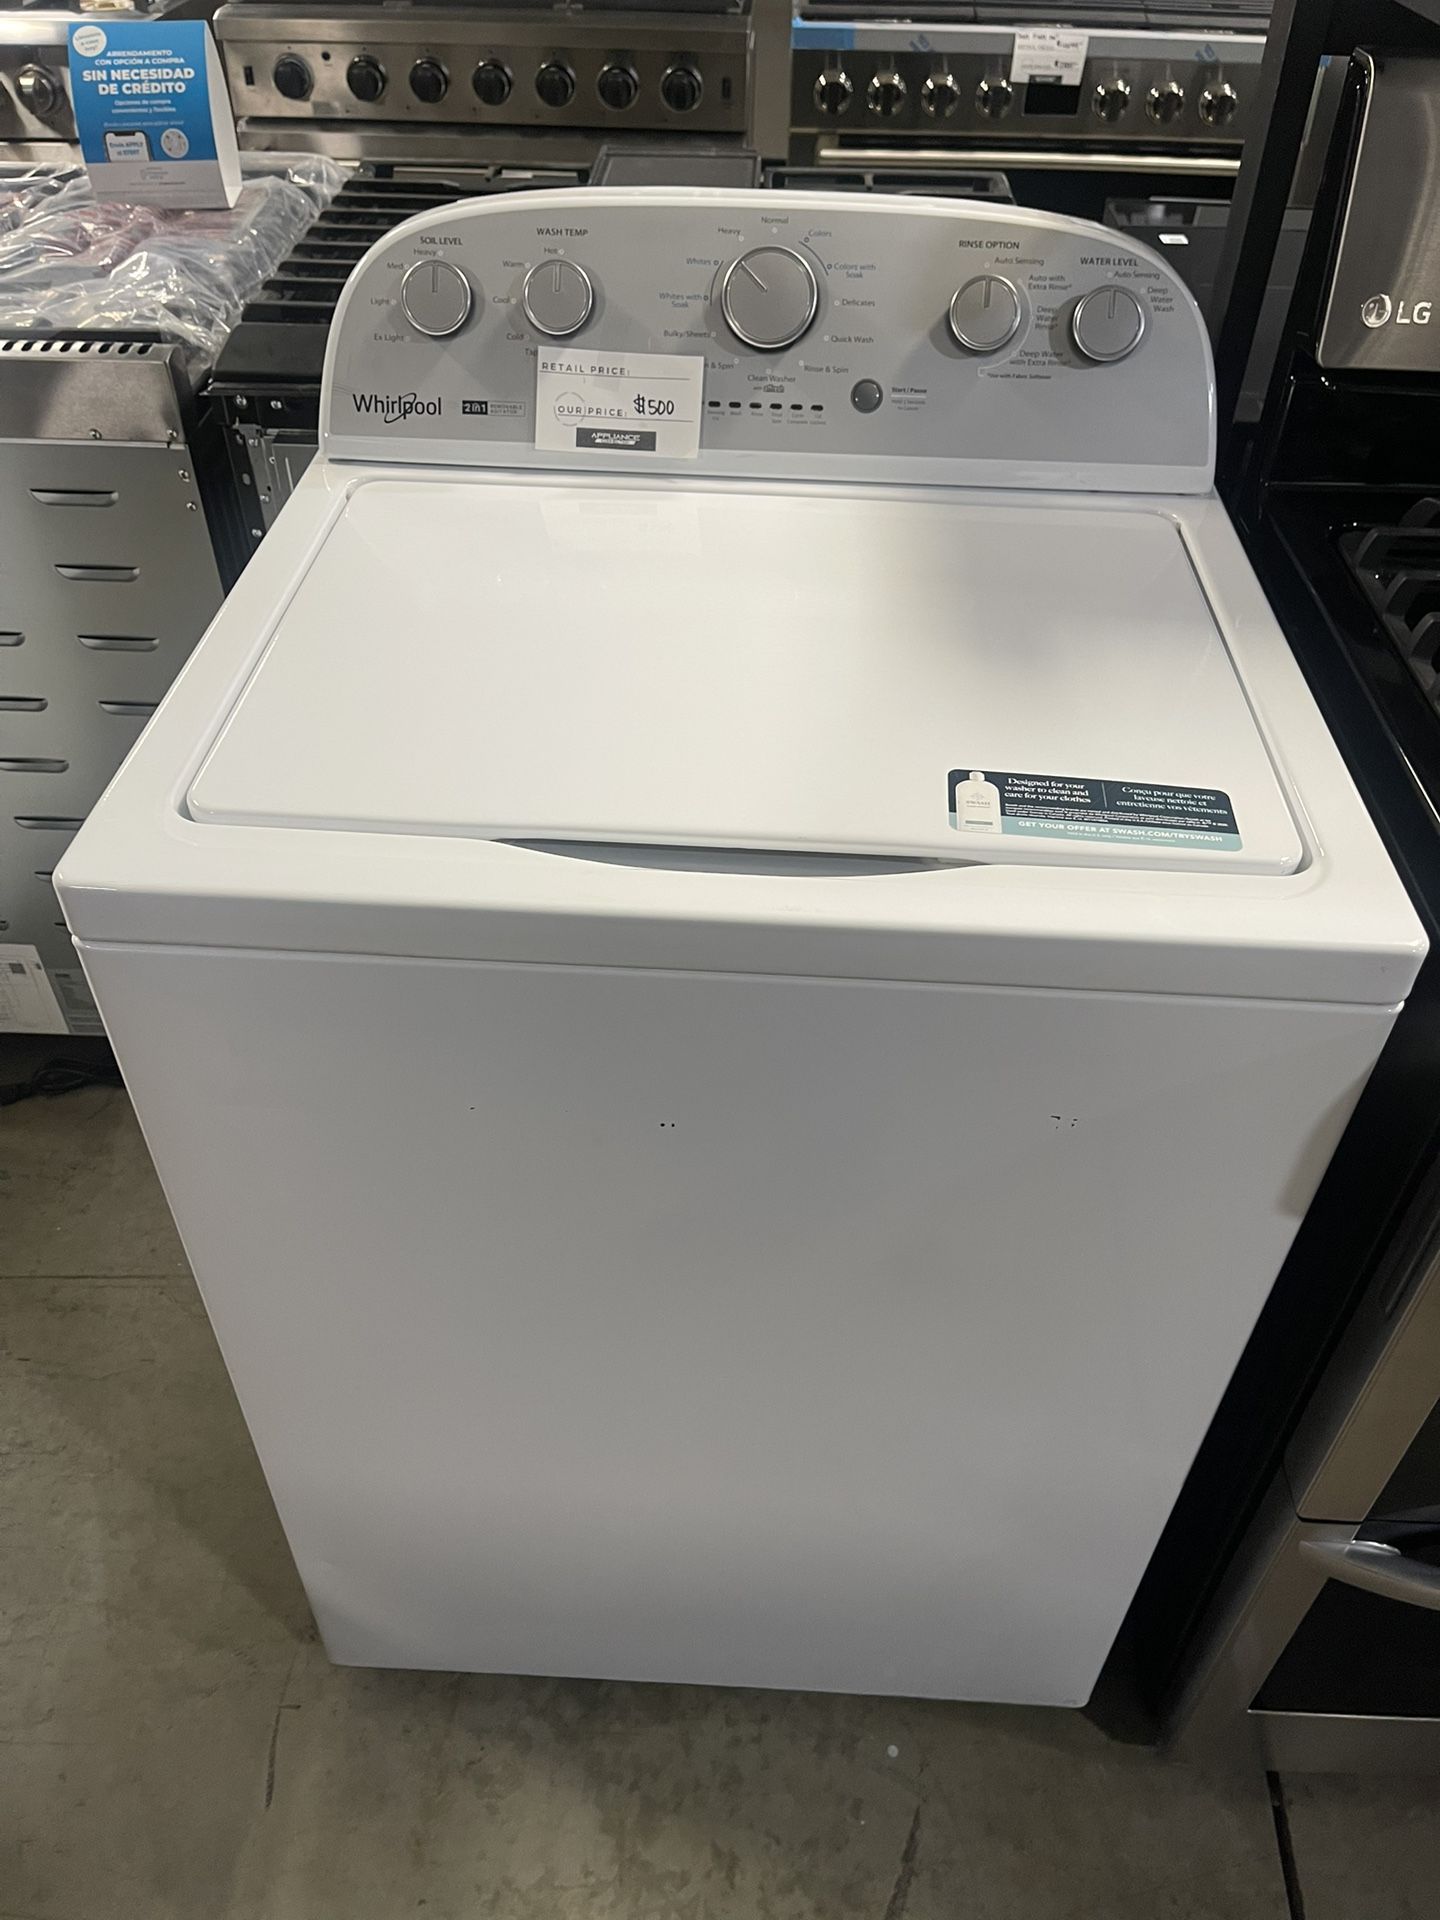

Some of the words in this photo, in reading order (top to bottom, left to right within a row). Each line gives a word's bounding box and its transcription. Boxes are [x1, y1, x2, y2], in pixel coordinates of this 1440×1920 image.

[94, 58, 112, 66] CON
[113, 57, 143, 65] OPCIÓN
[151, 57, 185, 65] COMPRA
[82, 69, 107, 81] SIN
[110, 67, 195, 81] NECESIDAD
[98, 83, 119, 95] DE
[122, 80, 186, 95] CRÉDITO
[761, 216, 789, 224] Normal
[537, 227, 562, 236] WASH
[564, 228, 588, 237] TEMP
[718, 227, 741, 235] Heavy
[808, 229, 832, 237] Colors
[420, 236, 438, 244] SOIL
[439, 237, 463, 246] LEVEL
[959, 240, 983, 249] RINSE
[985, 240, 1020, 250] OPTION
[413, 248, 436, 257] Heavy
[544, 247, 558, 255] Hot
[502, 260, 525, 268] Warm
[686, 257, 712, 265] Whites
[1015, 257, 1045, 267] Sensing
[1080, 257, 1111, 266] WATER
[1112, 258, 1138, 267] LEVEL
[387, 262, 403, 270] Med
[1113, 270, 1132, 278] Auto
[1133, 271, 1160, 280] Sensing
[1147, 287, 1168, 295] Deep
[492, 296, 511, 304] Cool
[659, 292, 684, 300] Whites
[1150, 296, 1174, 304] Water
[370, 297, 390, 306] Light
[842, 298, 875, 307] Delicates
[1153, 305, 1175, 313] Wash
[1396, 300, 1432, 324] LG
[374, 333, 383, 341] Ex
[384, 333, 404, 343] Light
[506, 332, 524, 341] Cold
[831, 335, 852, 343] Quick
[853, 335, 874, 343] Wash
[1019, 350, 1040, 358] Deep
[542, 362, 585, 373] RETAIL
[590, 365, 631, 376] PRICE:
[718, 362, 734, 371] Spin
[804, 365, 823, 373] Rinse
[832, 366, 849, 374] Spin
[747, 374, 768, 382] Clean
[769, 375, 796, 383] Washer
[353, 392, 442, 422] Whirlpool
[633, 393, 675, 416] $500
[558, 405, 582, 414] OUR
[588, 407, 628, 417] PRICE:
[591, 432, 641, 442] APPLIANCE
[1008, 777, 1050, 787] Designed
[1004, 785, 1035, 793] washer
[1122, 786, 1152, 796] Conçu
[1153, 789, 1174, 797] pour
[1175, 791, 1192, 800] que
[1193, 793, 1216, 801] votre
[1024, 792, 1037, 800] for
[1134, 794, 1165, 803] laveuse
[1167, 797, 1197, 805] nettoie
[1116, 800, 1165, 809] entretienne
[1183, 804, 1228, 815] vêtements
[1038, 822, 1064, 830] YOUR
[1066, 824, 1097, 832] OFFER
[1112, 827, 1223, 842] SWASH.COM/TRYSWASH
